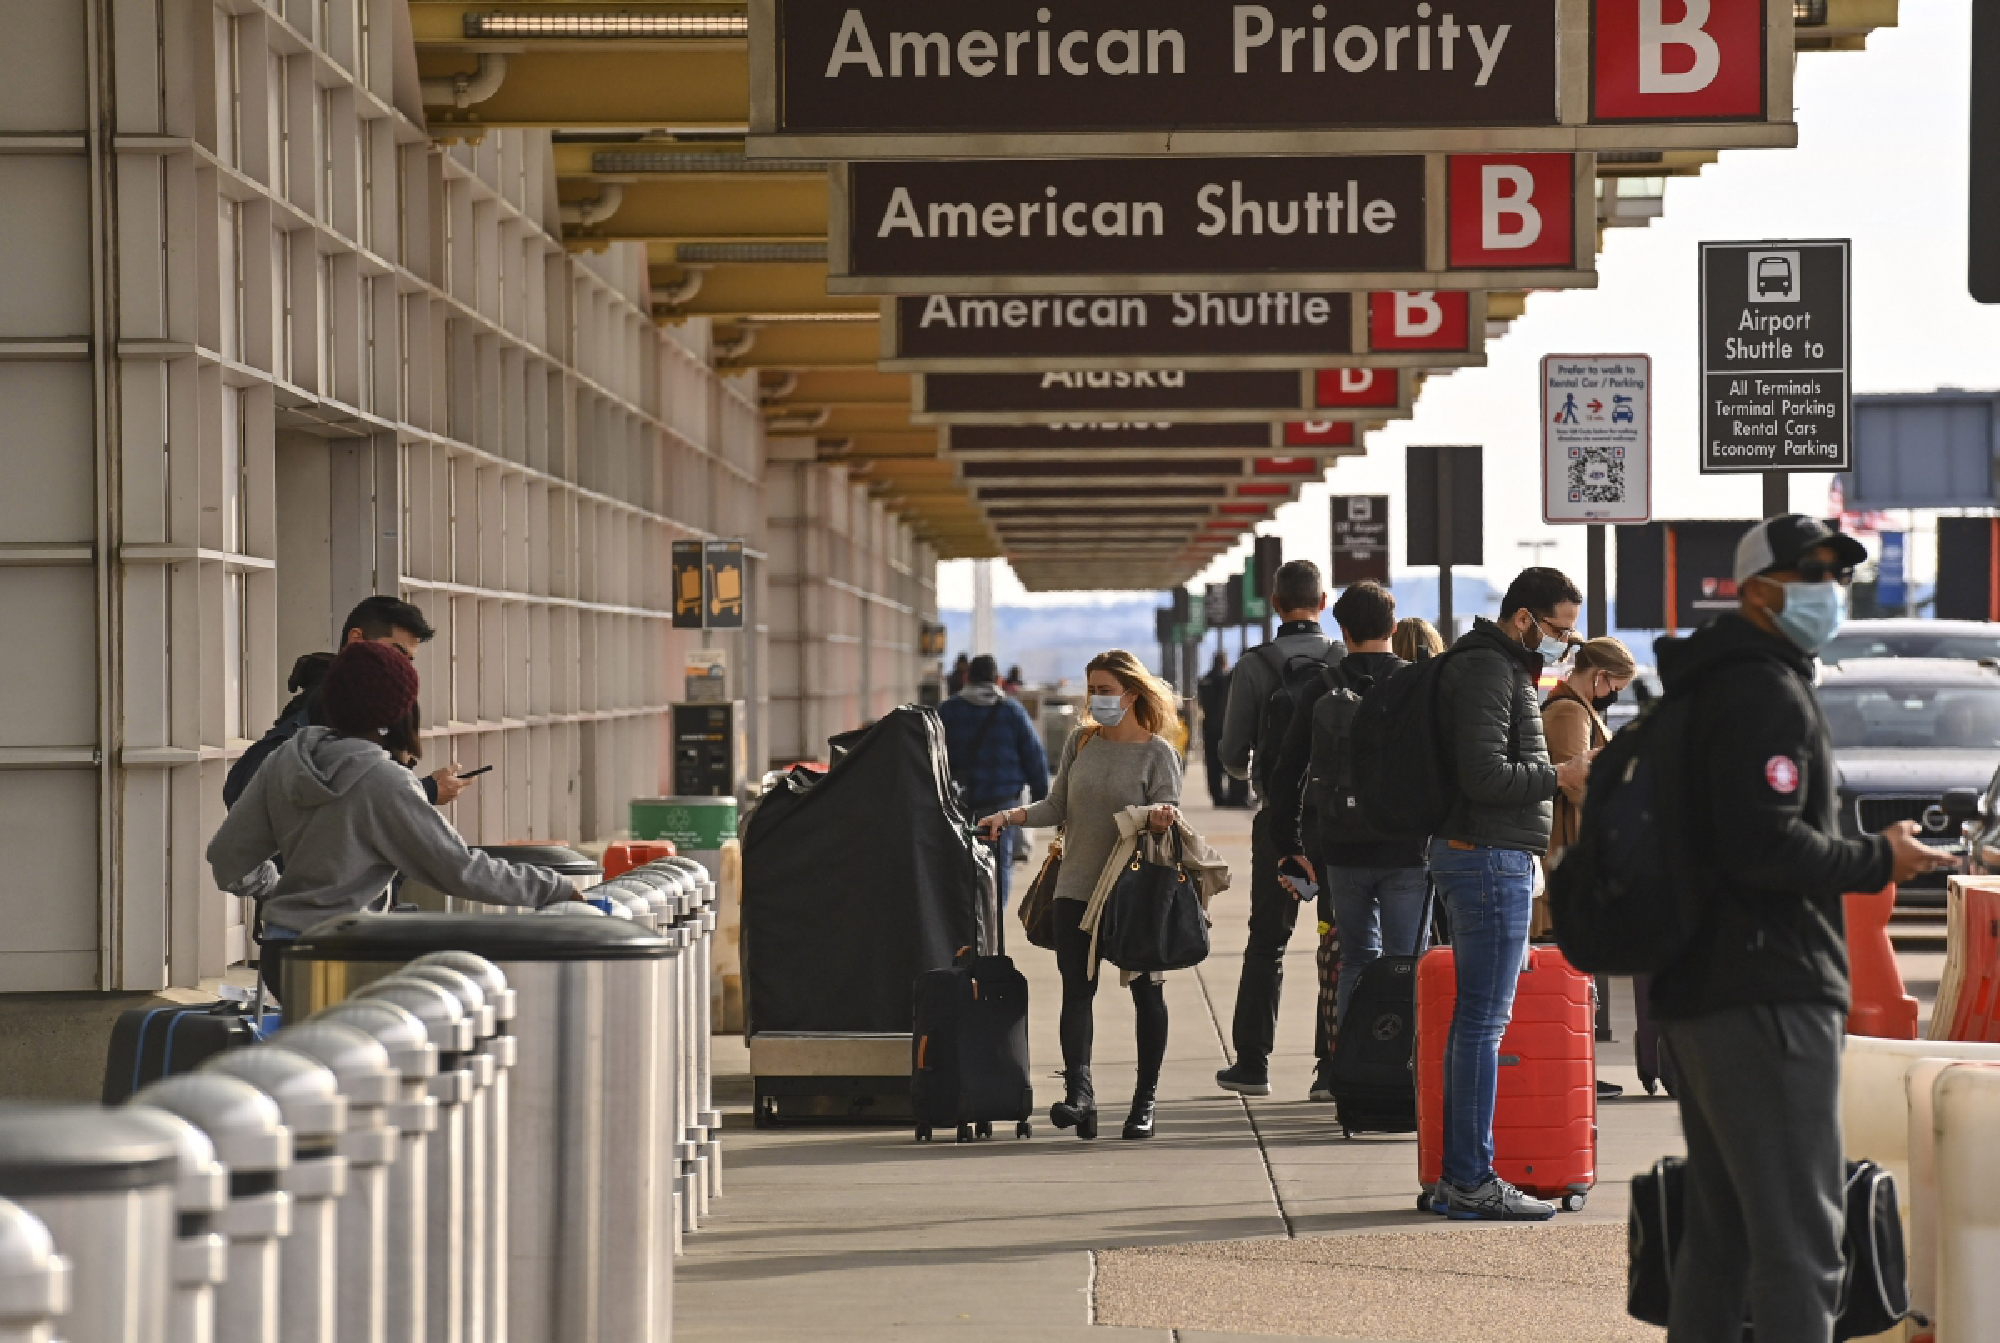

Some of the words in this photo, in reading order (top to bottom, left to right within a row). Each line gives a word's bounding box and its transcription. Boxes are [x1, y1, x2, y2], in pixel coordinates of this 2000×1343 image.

[825, 7, 1186, 78] American
[1232, 2, 1512, 86] Priority
[1639, 0, 1720, 94] B
[877, 186, 1164, 238] American
[1197, 180, 1396, 236] Shuttle
[1482, 164, 1543, 250] B
[919, 294, 1147, 328] American
[1172, 292, 1331, 327] Shuttle
[1738, 308, 1812, 335] Airport
[1725, 337, 1793, 360] Shuttle
[1804, 340, 1825, 359] to
[1557, 364, 1586, 375] Prefer
[1588, 365, 1598, 375] to
[1601, 363, 1623, 375] walk
[1625, 364, 1636, 375] to
[1549, 377, 1579, 388] Rental
[1582, 377, 1598, 388] Car
[1609, 377, 1644, 390] Parking
[1729, 379, 1748, 396] All
[1755, 378, 1821, 396] Terminals
[1715, 399, 1775, 416] Terminal
[1782, 399, 1836, 418] Parking
[1733, 419, 1778, 436] Rental
[1785, 419, 1818, 436] Cars
[1712, 440, 1777, 459] Economy
[1784, 440, 1838, 458] Parking
